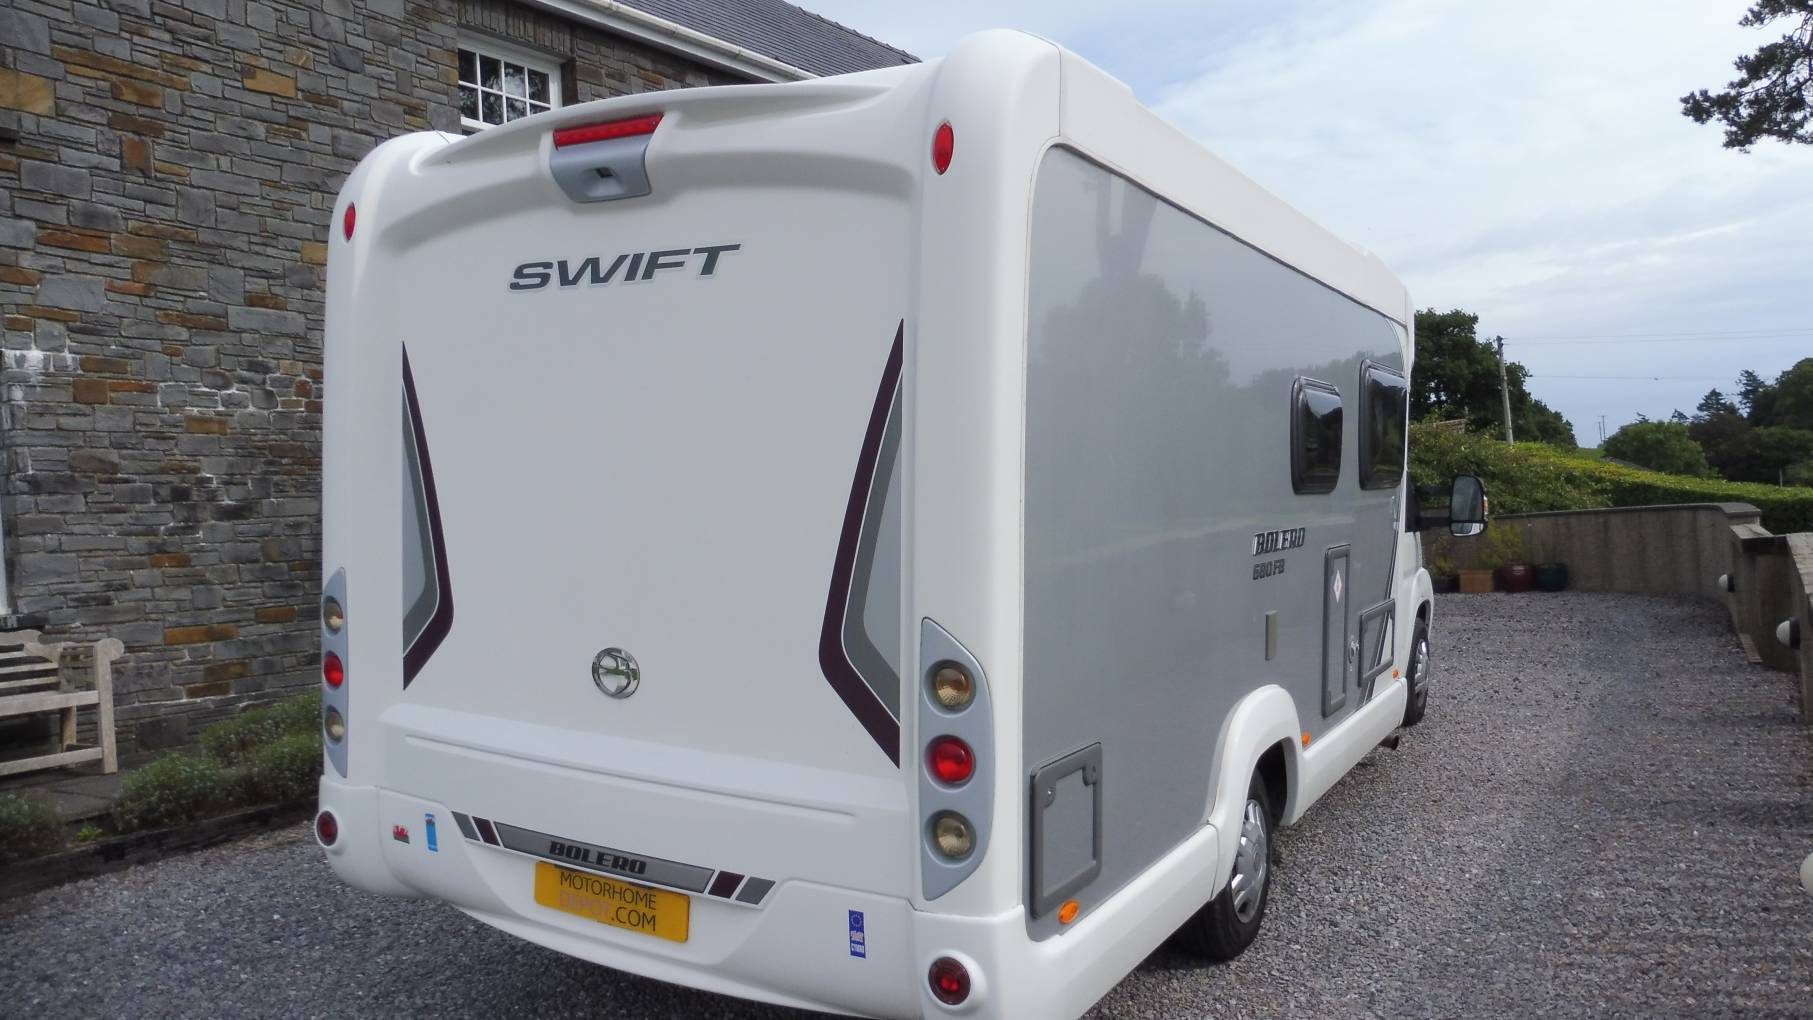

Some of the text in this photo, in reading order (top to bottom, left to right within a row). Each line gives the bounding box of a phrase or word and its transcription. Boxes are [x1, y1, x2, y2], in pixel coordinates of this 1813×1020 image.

[510, 244, 741, 290] SWIFT
[1252, 527, 1306, 557] BOLERO
[549, 841, 647, 874] BOLERO
[560, 871, 656, 910] MOTORHOME
